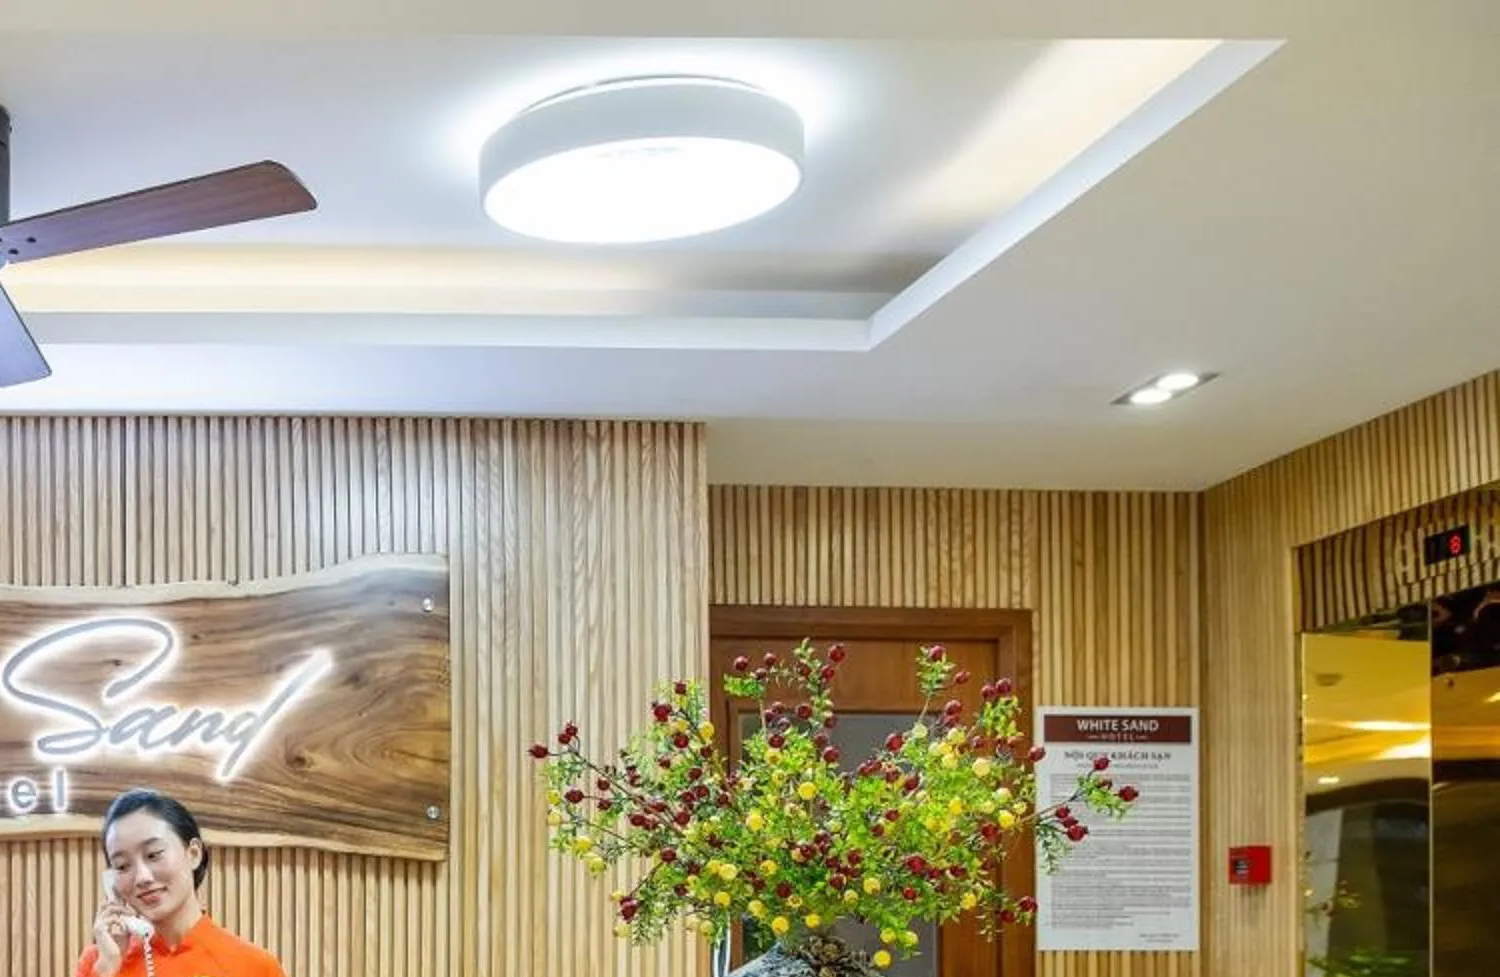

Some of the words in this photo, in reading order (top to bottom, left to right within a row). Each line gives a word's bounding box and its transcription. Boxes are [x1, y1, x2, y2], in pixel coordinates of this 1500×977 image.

[1, 616, 332, 781] Sand
[1076, 719, 1118, 732] WHITE
[1121, 719, 1159, 731] SAND
